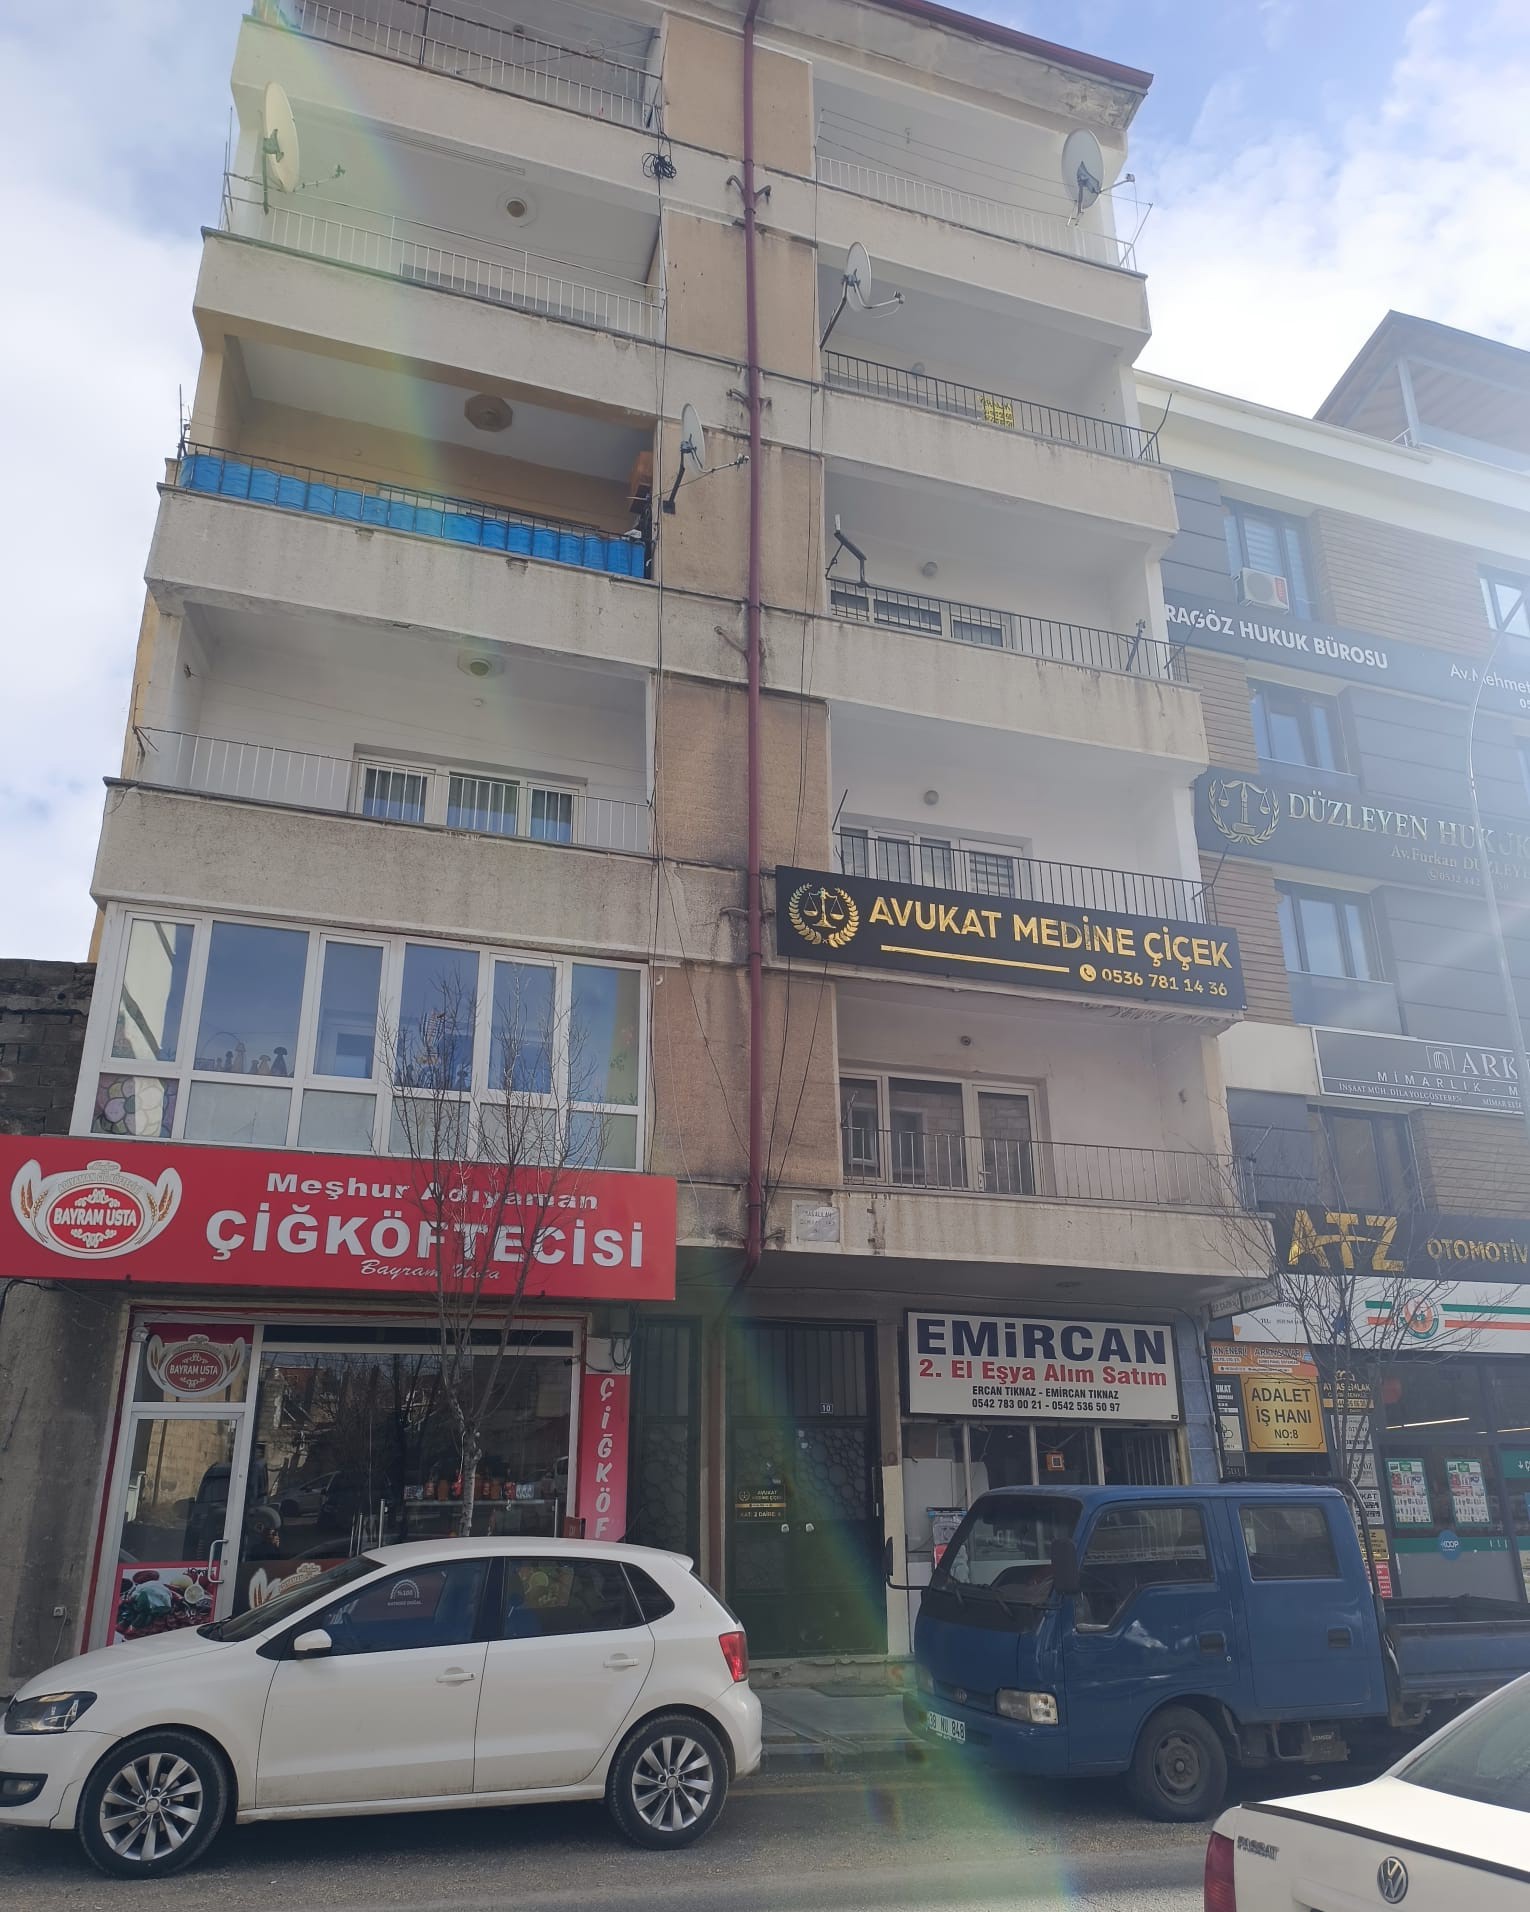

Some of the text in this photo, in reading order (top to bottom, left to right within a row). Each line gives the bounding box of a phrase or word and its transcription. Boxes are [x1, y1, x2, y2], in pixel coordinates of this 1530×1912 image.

[1240, 621, 1309, 652] HUKUK
[1313, 636, 1388, 669] BÜROSU
[1289, 790, 1428, 841] DÜZLEYEN
[868, 896, 1233, 971] AVUKAT MEDİNE ÇİÇEK
[1101, 968, 1228, 996] 0536 781 14 36
[266, 1172, 410, 1200] Meşhur
[53, 1207, 137, 1227] BAYRAM USTA
[205, 1202, 643, 1268] ÇİĞKÖFTECİSİ
[1287, 1208, 1405, 1272] ATZ
[1426, 1237, 1528, 1264] OTOMOTİV
[360, 1259, 440, 1280] Bayram
[169, 1364, 218, 1376] BAYRAM USTA
[918, 1358, 1167, 1386] 2. El Eşya Alım Satım
[972, 1385, 1001, 1396] ERCAN
[1005, 1387, 1037, 1397] TIKNAZ
[1045, 1386, 1086, 1399] EMİRCAN
[1089, 1389, 1119, 1400] TIKNAZ
[972, 1398, 995, 1409] 0542
[998, 1399, 1015, 1409] 783
[1017, 1400, 1029, 1409] 00
[1031, 1400, 1042, 1410] 21
[1052, 1401, 1075, 1411] 0542
[1077, 1402, 1094, 1411] 536
[1096, 1402, 1107, 1412] 50
[1109, 1402, 1120, 1412] 97
[1251, 1387, 1311, 1403] ADALET
[1255, 1405, 1312, 1427] İŞ HANI
[1274, 1429, 1299, 1439] NO:8
